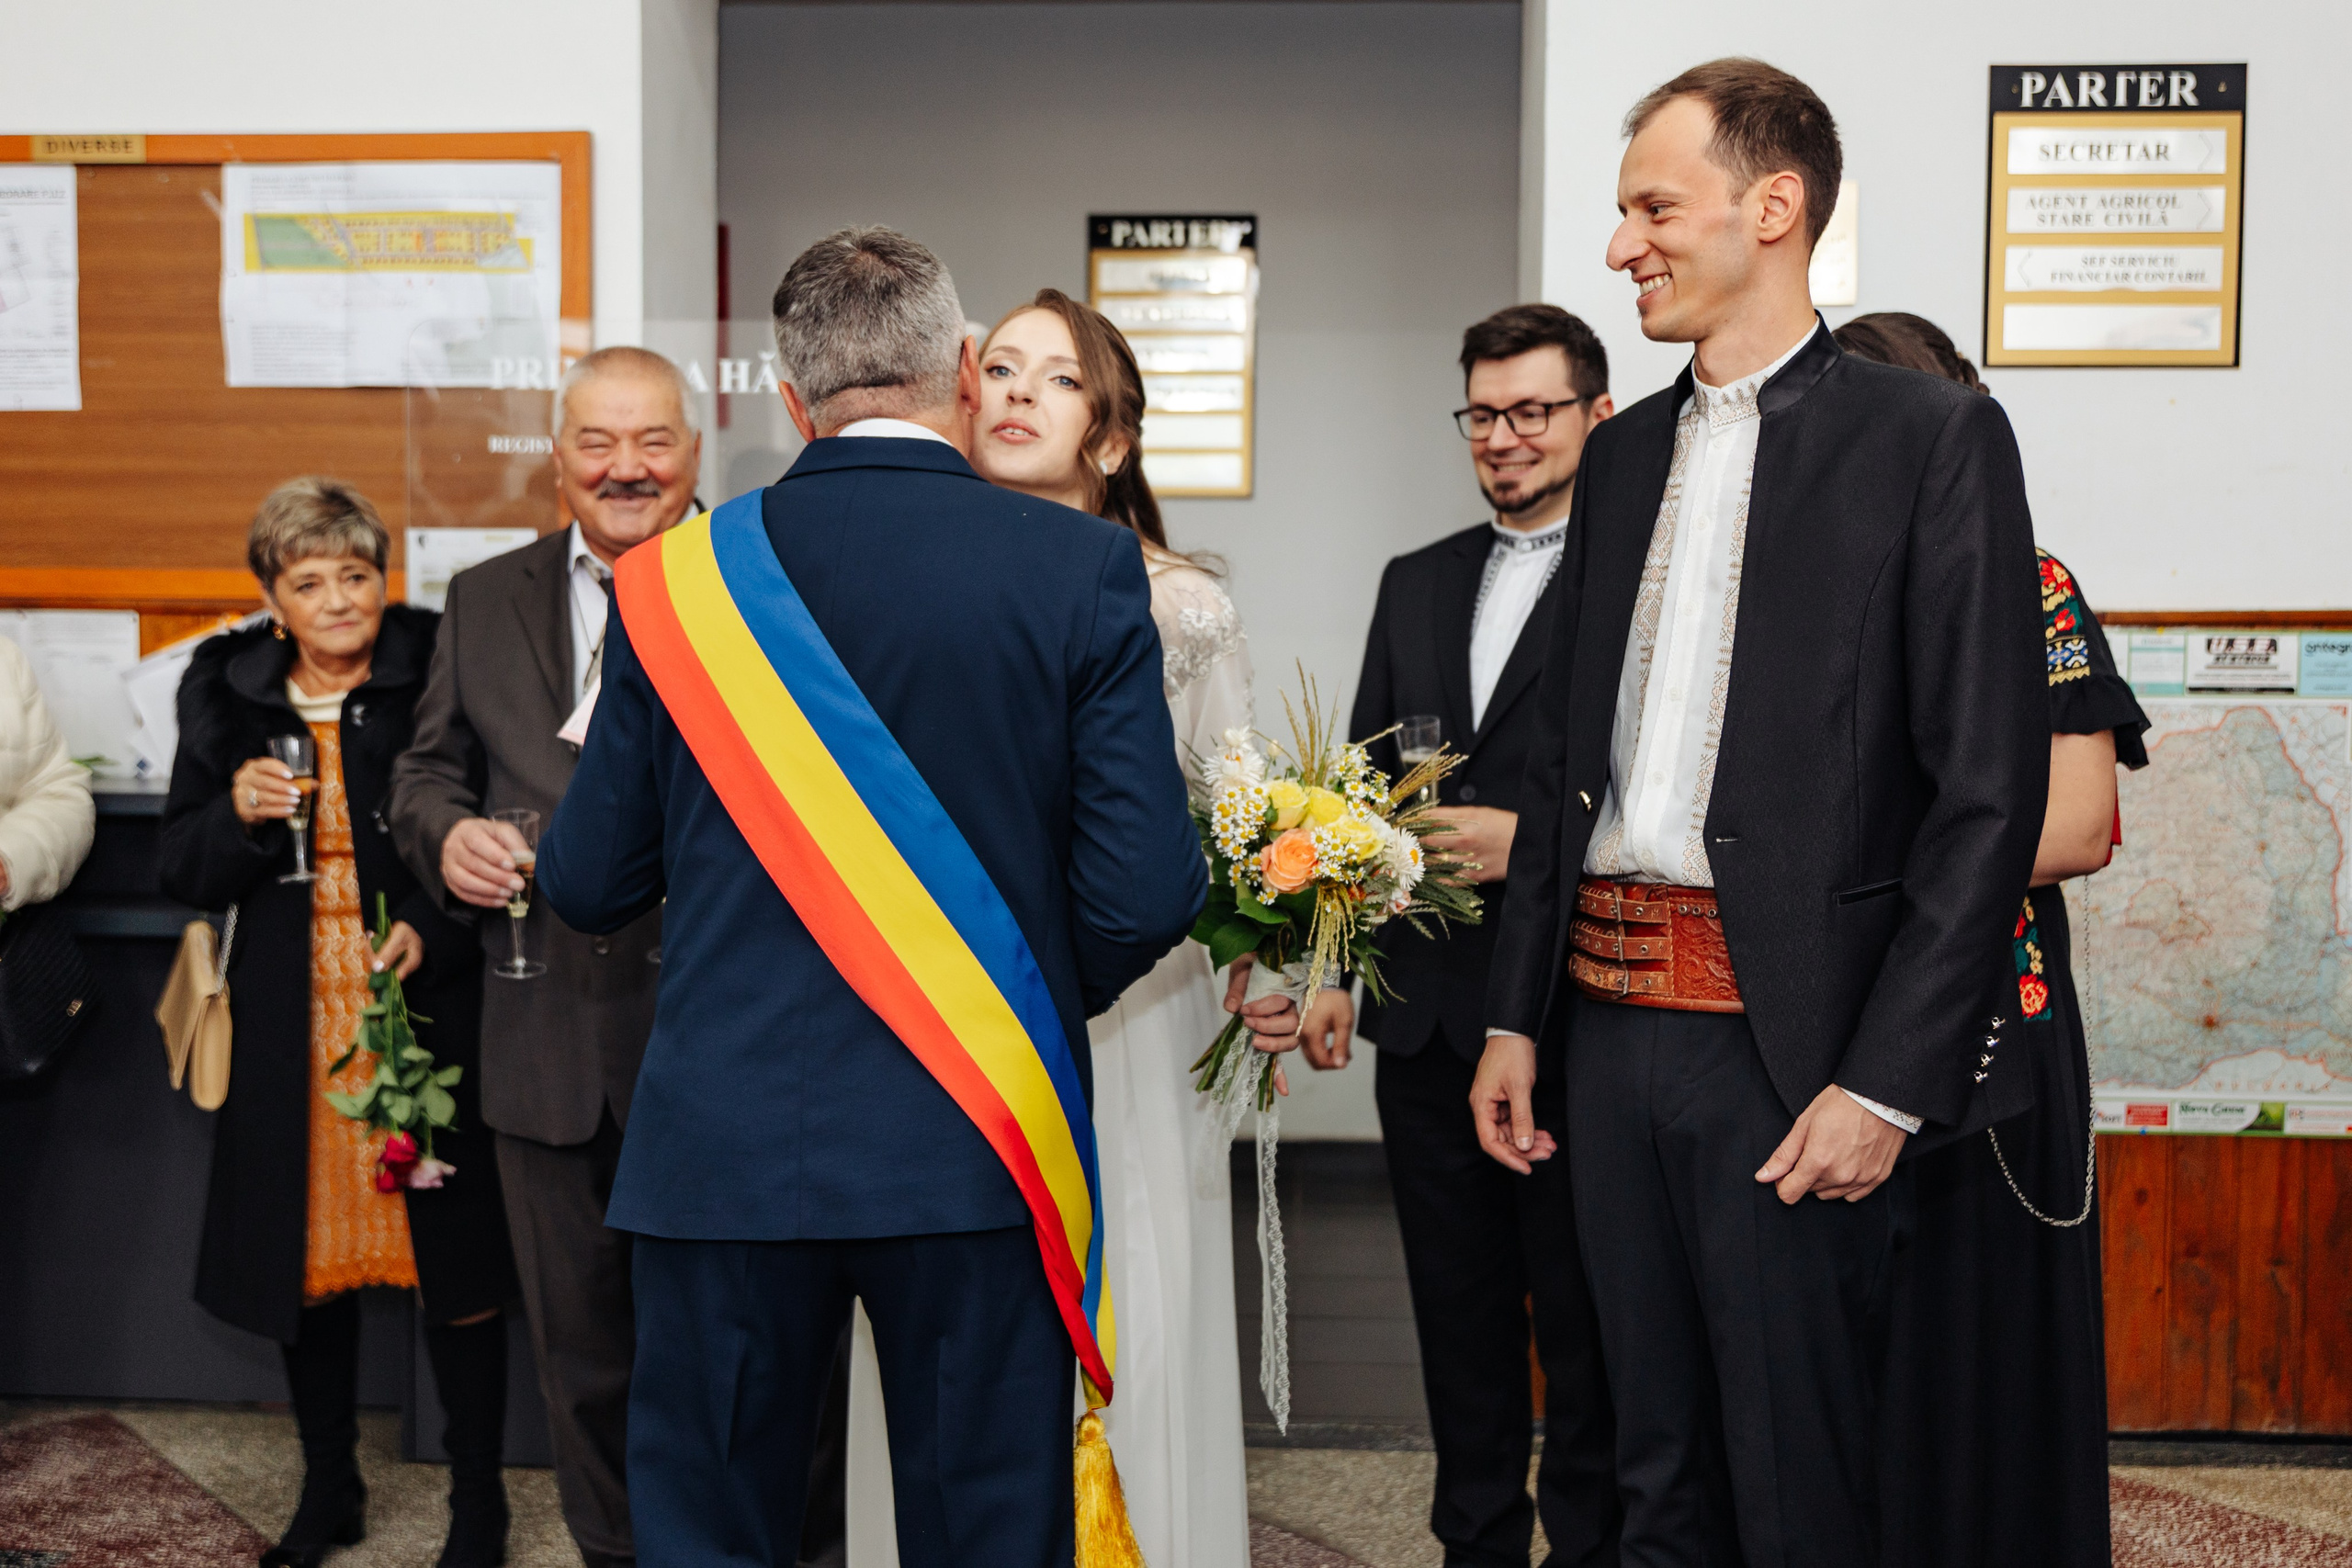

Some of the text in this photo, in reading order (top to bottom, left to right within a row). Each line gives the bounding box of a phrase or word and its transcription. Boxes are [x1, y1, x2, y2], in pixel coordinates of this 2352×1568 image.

[2018, 70, 2199, 107] PARTER
[2039, 142, 2171, 162] SECRETAR
[2025, 193, 2184, 210] AGENT AGRICOL
[2037, 212, 2094, 227] STARE
[718, 352, 779, 394] HĂ
